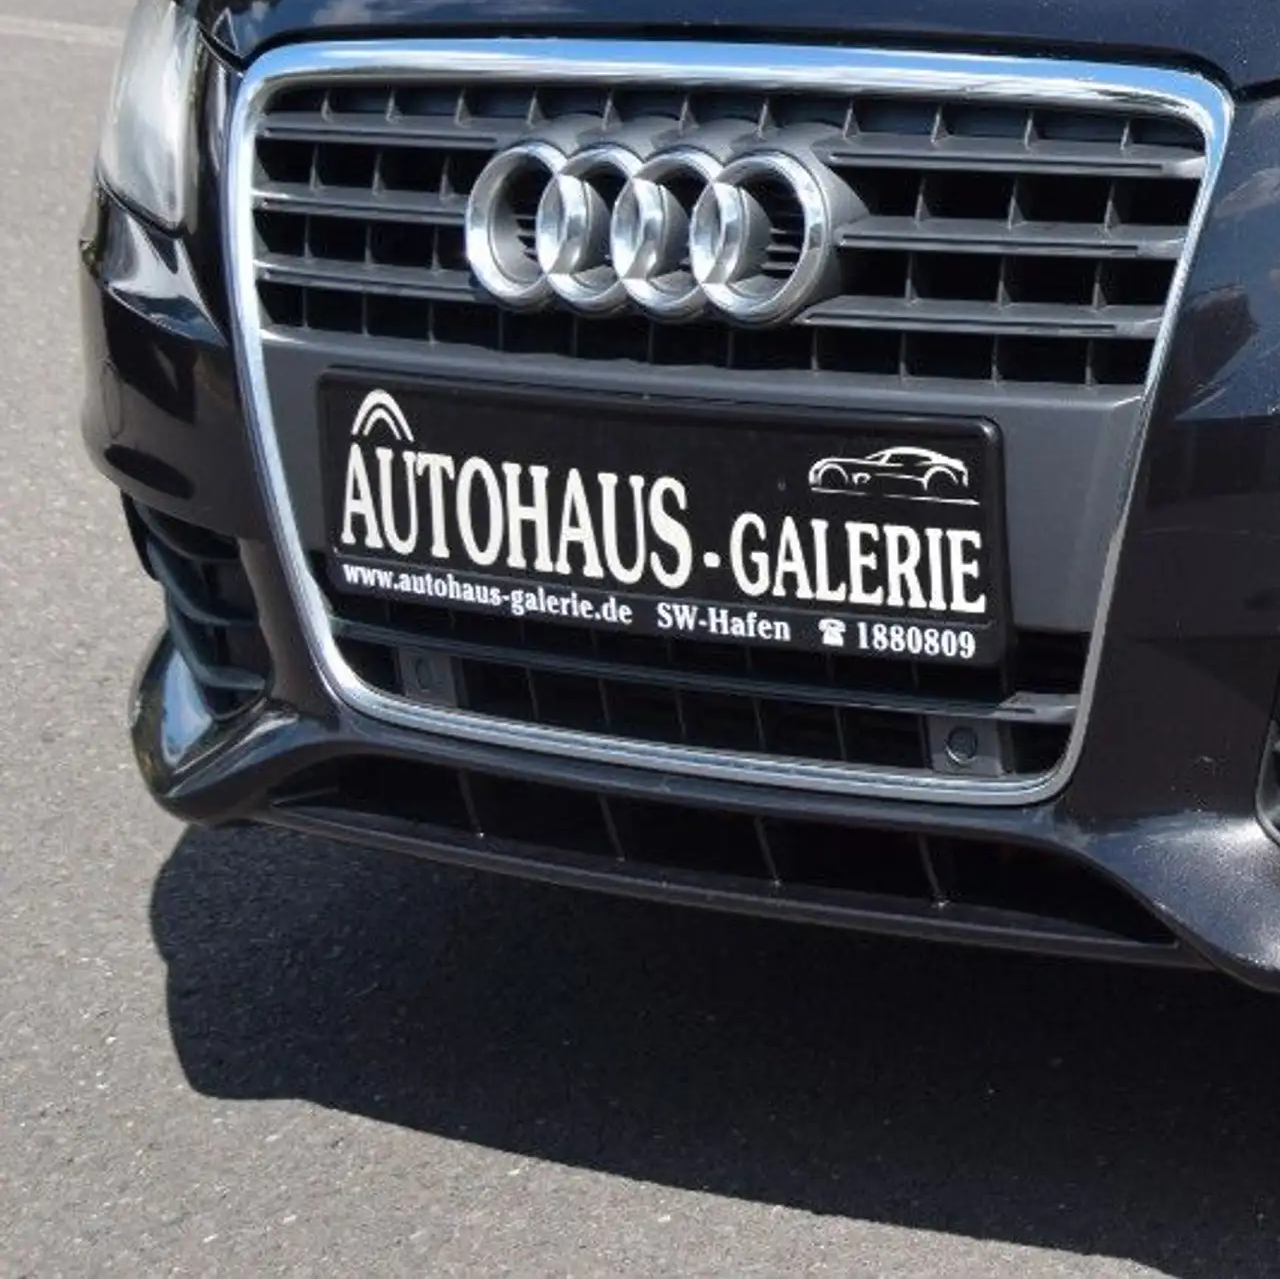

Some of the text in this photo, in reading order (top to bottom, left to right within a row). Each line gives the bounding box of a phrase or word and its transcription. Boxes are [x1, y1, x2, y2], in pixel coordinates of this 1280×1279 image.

[342, 563, 976, 659] www.autohaus-galerie.de SW-Hafen 1880809
